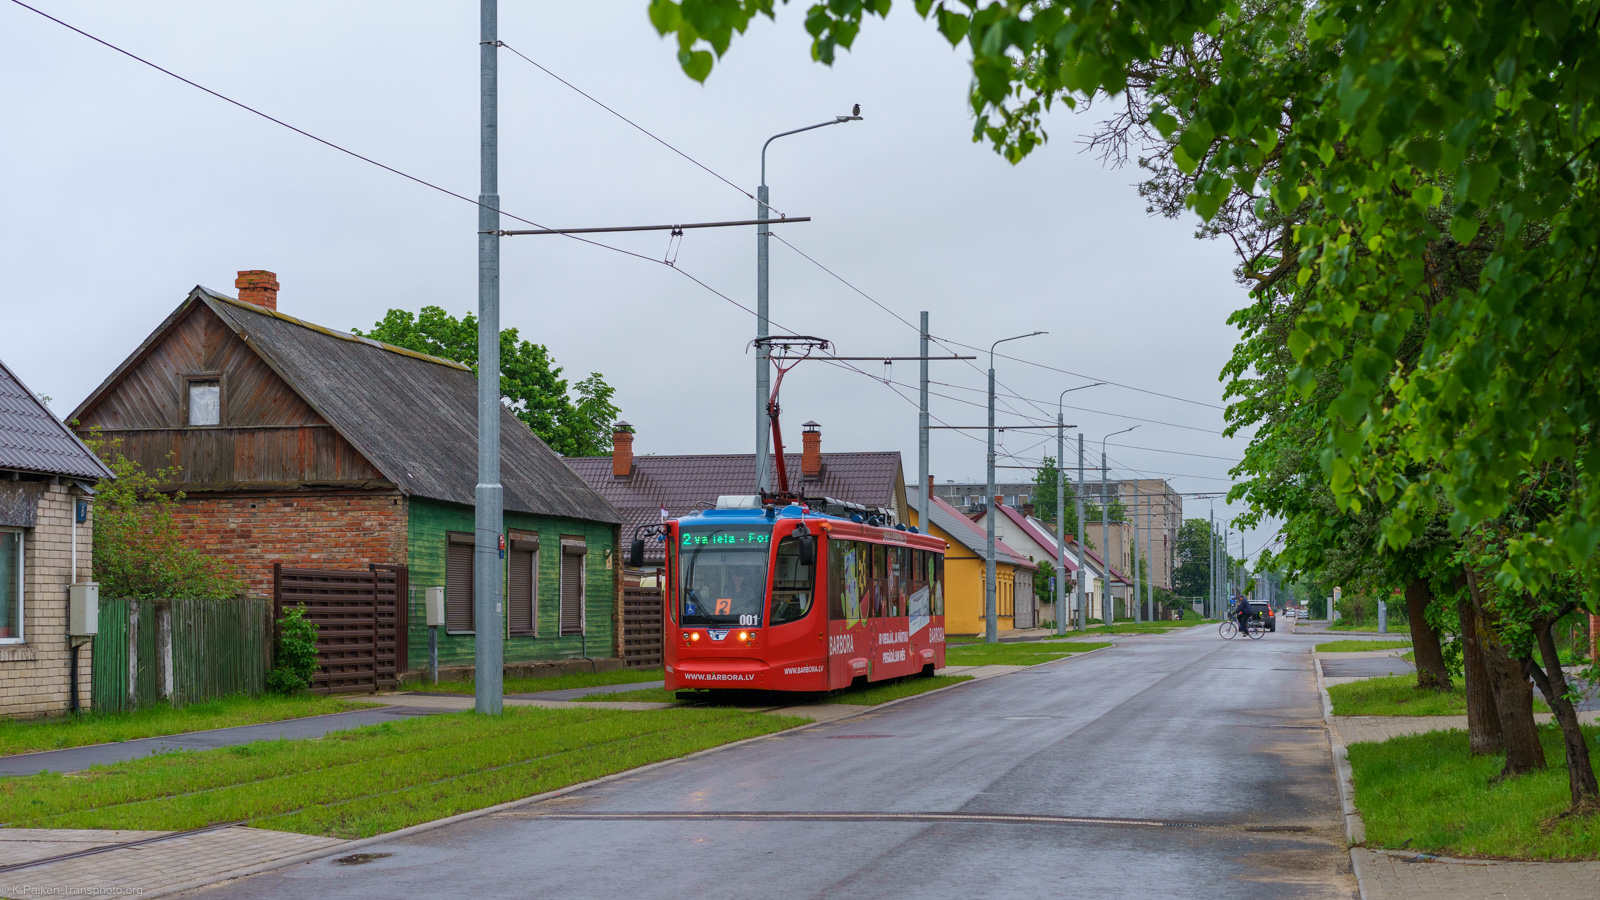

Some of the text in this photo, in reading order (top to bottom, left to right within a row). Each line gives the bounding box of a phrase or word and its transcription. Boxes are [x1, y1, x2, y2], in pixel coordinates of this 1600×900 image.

[682, 533, 692, 545] 2
[717, 600, 729, 614] 2
[739, 614, 759, 626] 001
[829, 634, 854, 655] BARBORA
[784, 665, 824, 675] WWW.BARBORA.LV
[684, 672, 755, 681] WWW.BARBORA.LV
